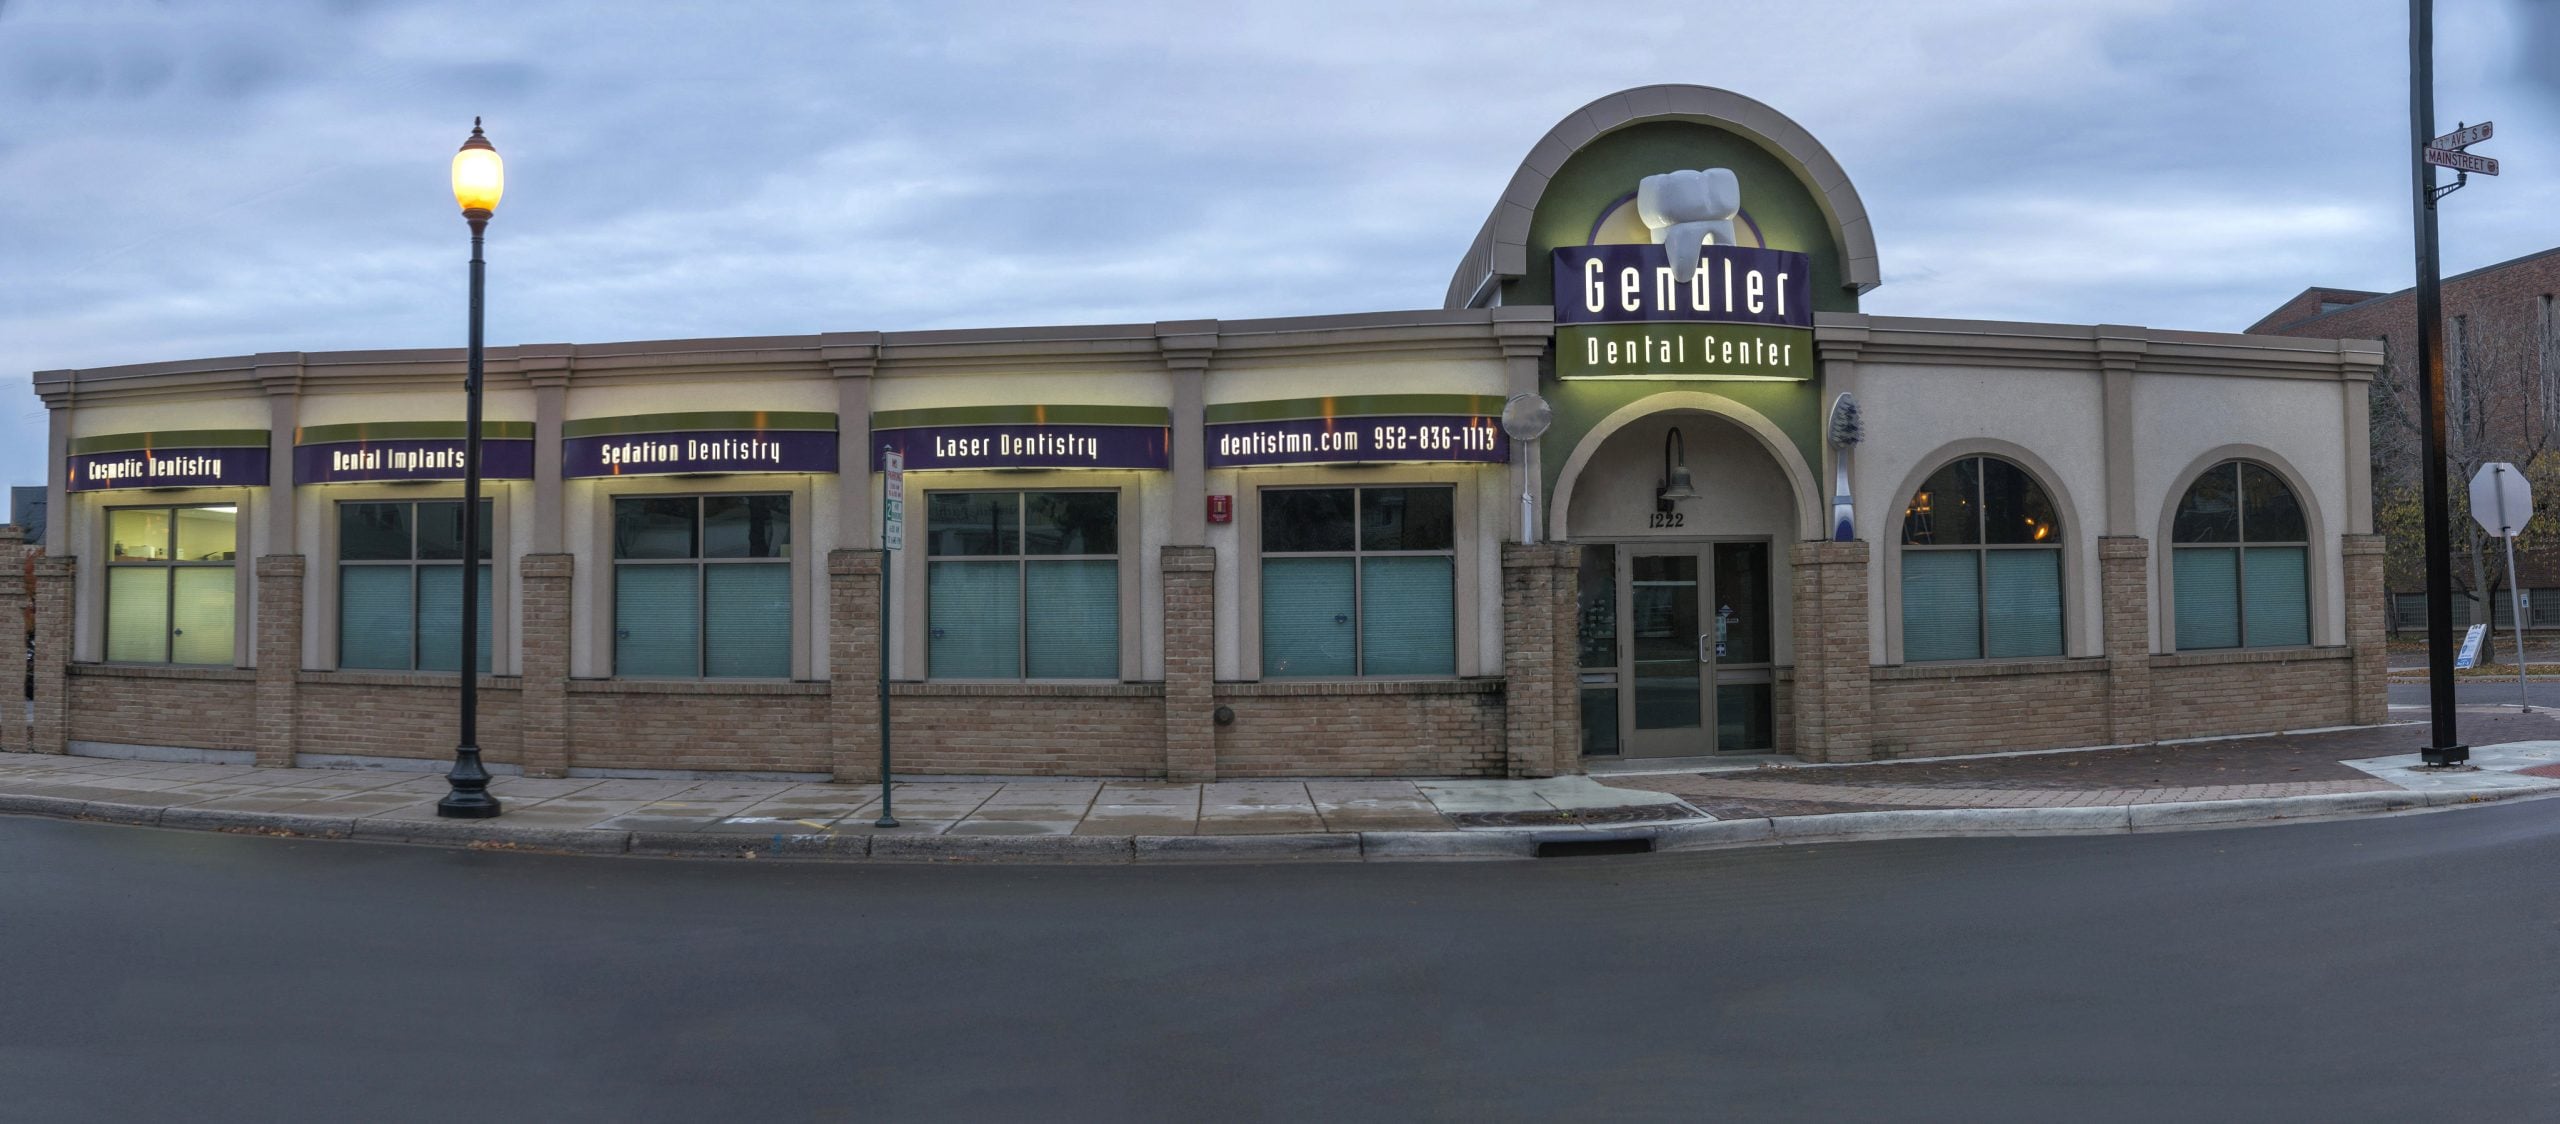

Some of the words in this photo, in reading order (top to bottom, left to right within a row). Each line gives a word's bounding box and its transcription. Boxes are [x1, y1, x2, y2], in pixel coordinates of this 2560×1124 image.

[2451, 131, 2467, 147] AVE
[2472, 128, 2478, 140] S
[2428, 149, 2485, 171] MAINSTREET
[1585, 257, 1789, 316] Gendler
[1588, 336, 1685, 365] Dental
[1705, 336, 1791, 366] Center
[601, 441, 679, 465] Sedation
[688, 438, 780, 463] Dentistry
[936, 436, 990, 457] Laser
[1001, 433, 1097, 459] Dentistry
[1220, 430, 1359, 456] dentistmn.com
[1374, 426, 1495, 450] 952-836-1113
[89, 458, 143, 480] Cosmetic
[149, 456, 222, 479] Dentistry
[333, 449, 381, 471] Dental
[388, 447, 465, 472] Implants
[1649, 513, 1684, 528] 1222
